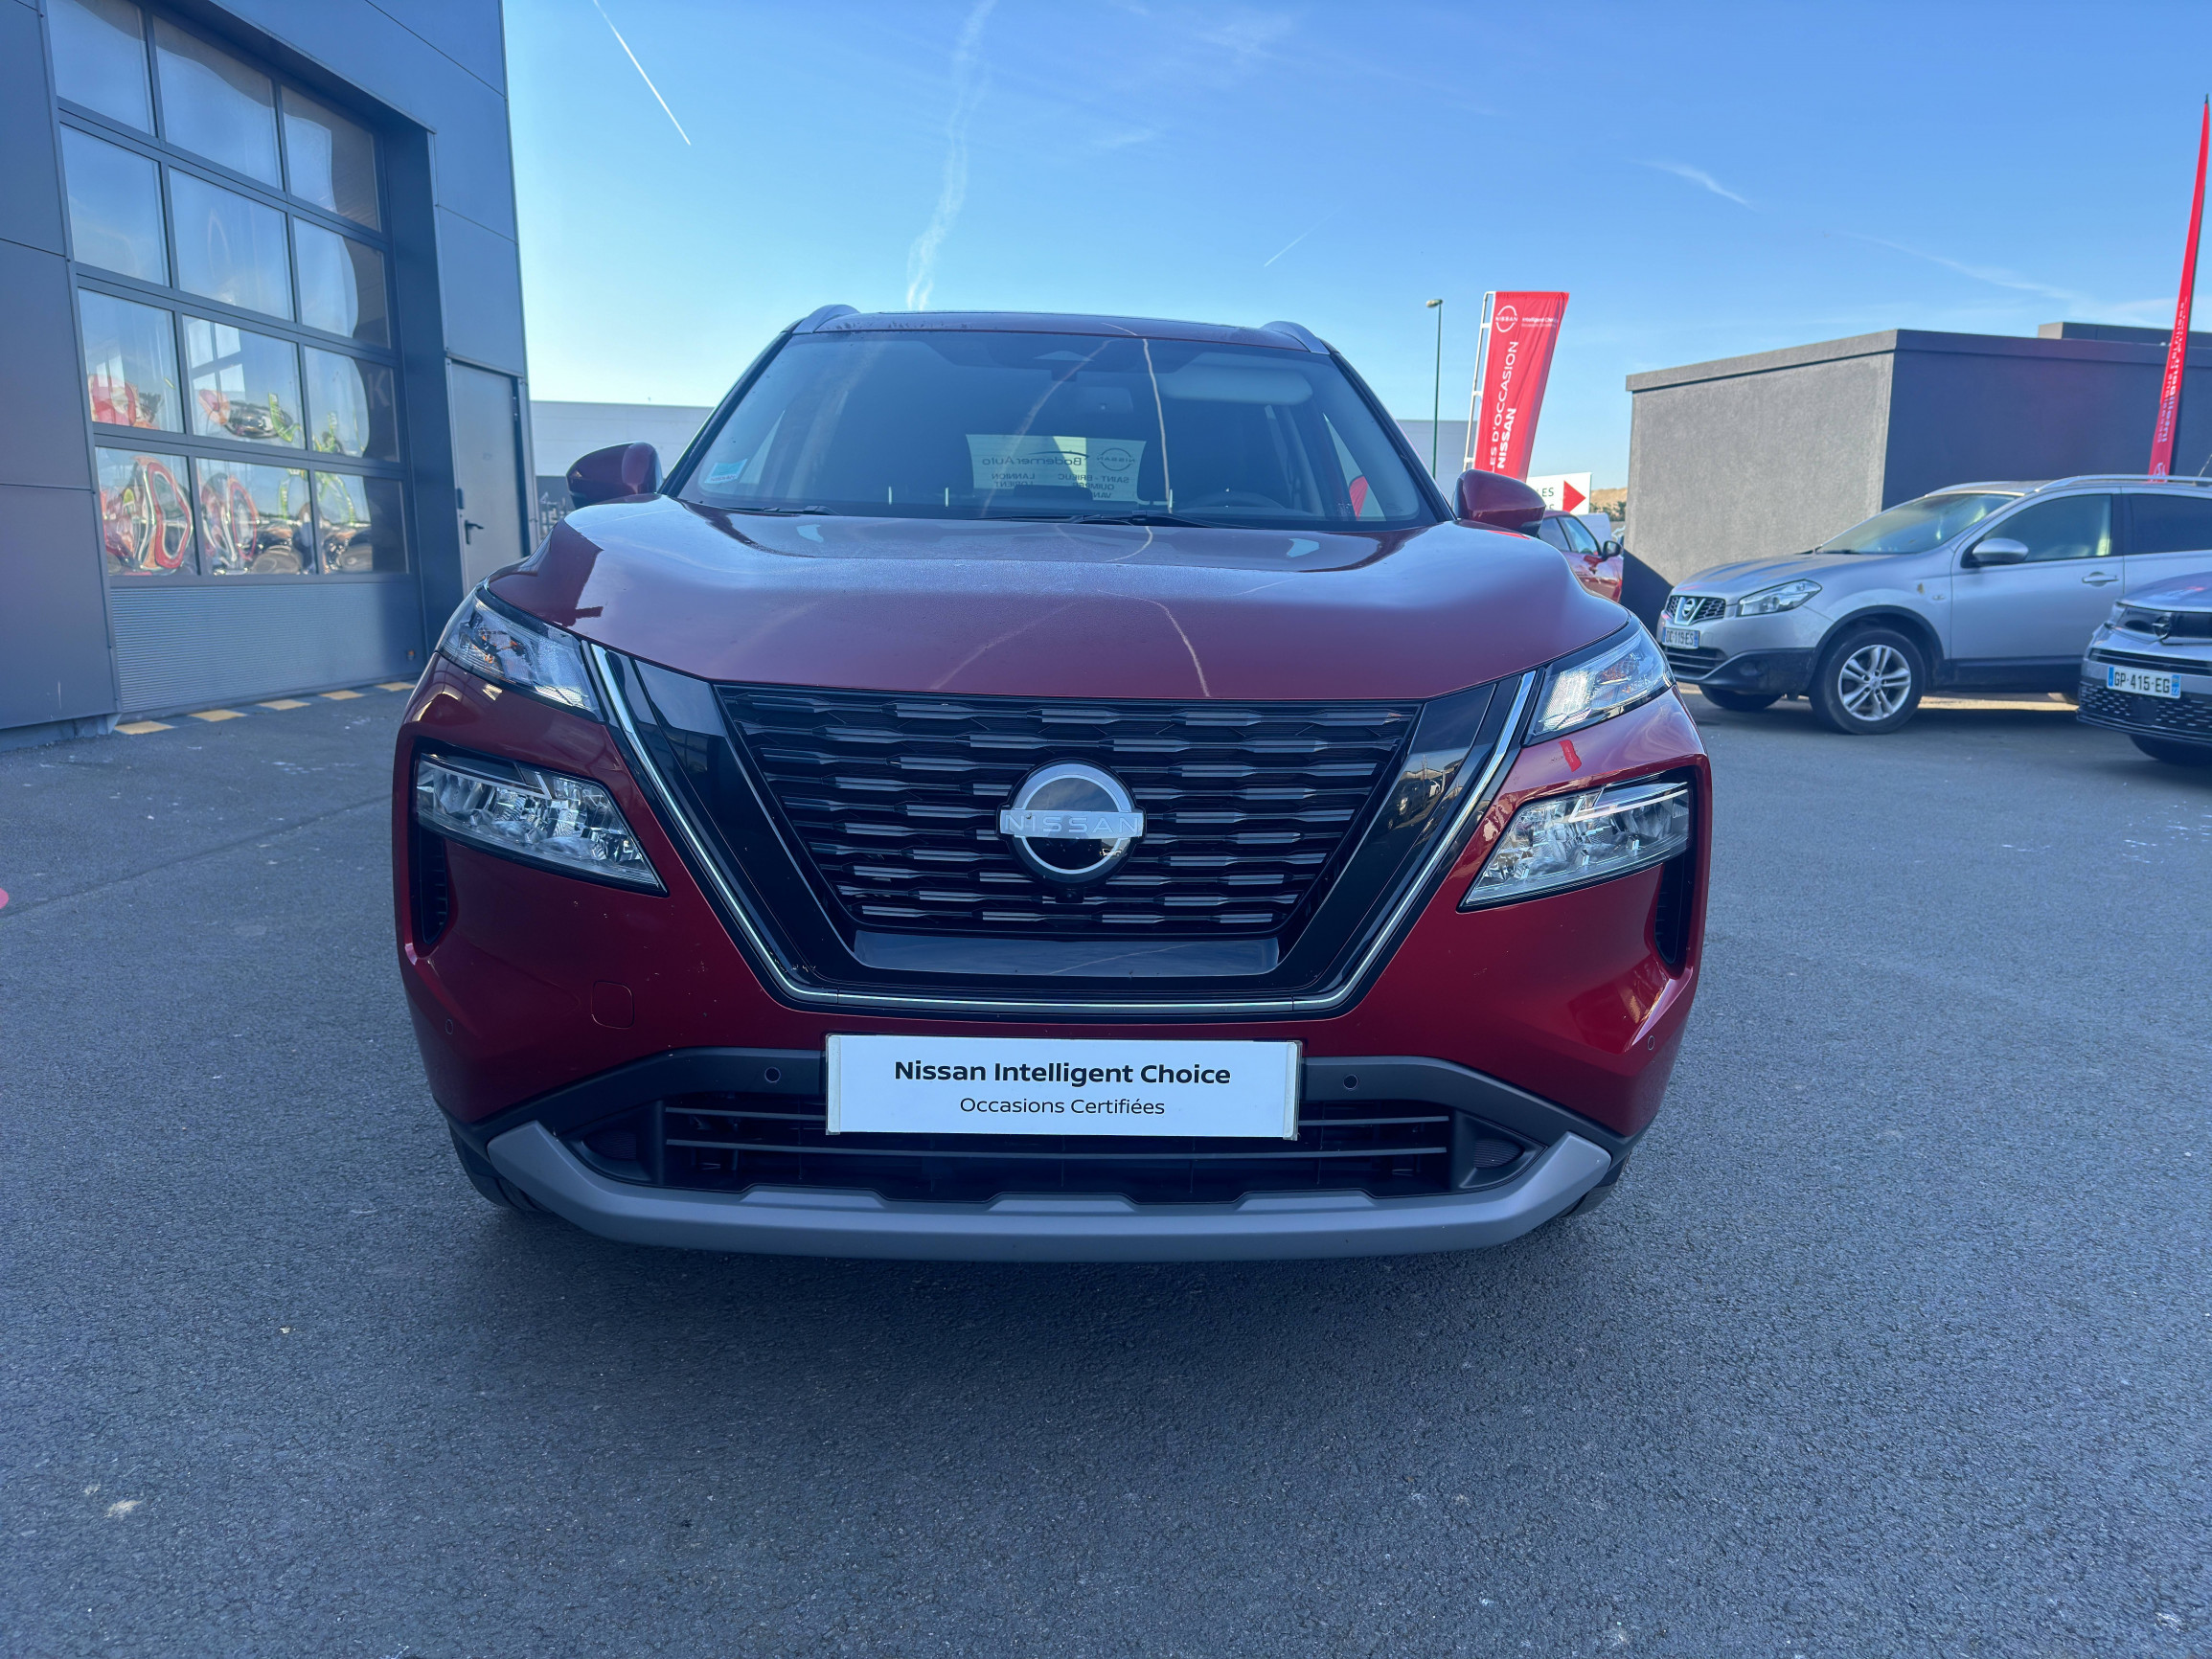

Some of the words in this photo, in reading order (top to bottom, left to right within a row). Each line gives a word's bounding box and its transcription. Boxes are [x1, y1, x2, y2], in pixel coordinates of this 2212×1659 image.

[1492, 341, 1519, 442] D'OCCASION
[1496, 407, 1516, 469] NISSAN
[1540, 487, 1555, 497] ES
[2113, 671, 2170, 693] GP-415-EG
[1005, 814, 1138, 833] NISSAN
[895, 1060, 986, 1080] Nissan
[994, 1062, 1133, 1087] Intelligent
[1140, 1063, 1231, 1084] Choice
[960, 1098, 1065, 1113] Occasions
[1070, 1098, 1165, 1114] Certifiées
